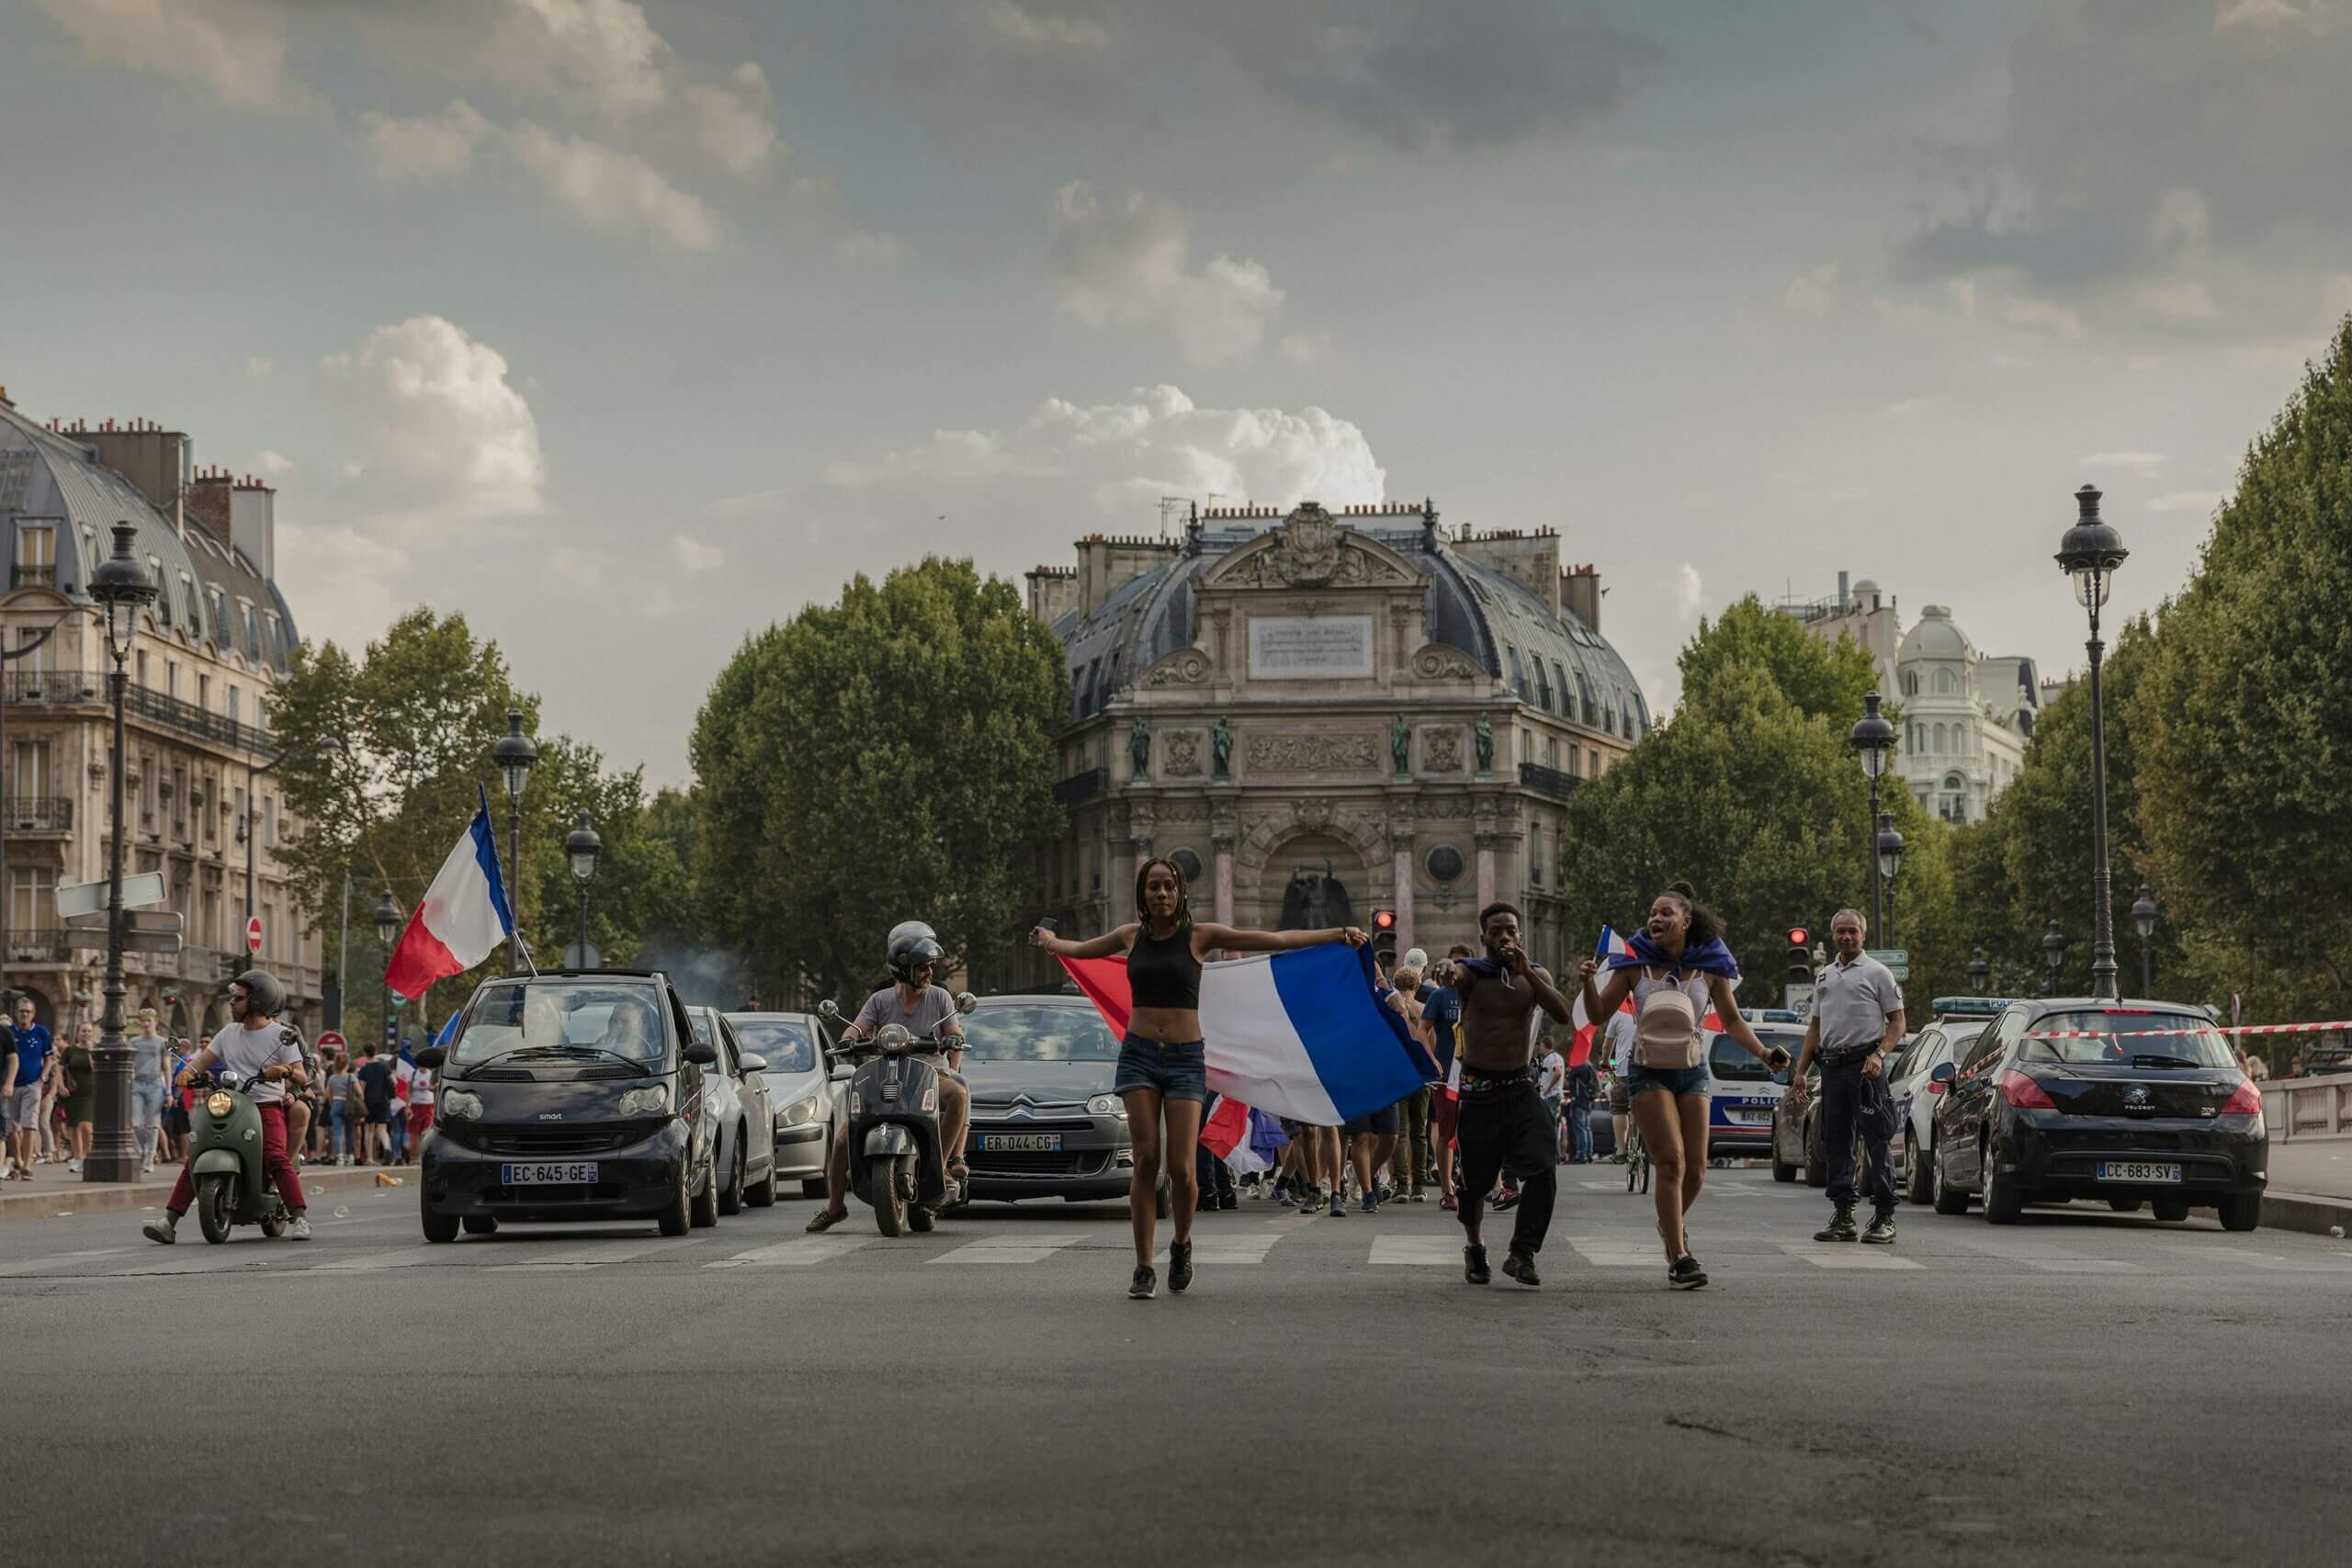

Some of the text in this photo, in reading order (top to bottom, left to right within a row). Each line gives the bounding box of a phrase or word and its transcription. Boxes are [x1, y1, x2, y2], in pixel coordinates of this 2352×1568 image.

[1991, 998, 2014, 1007] POLI
[514, 1165, 587, 1182] EC-645-GE
[2107, 1163, 2171, 1179] CC-683-SV
